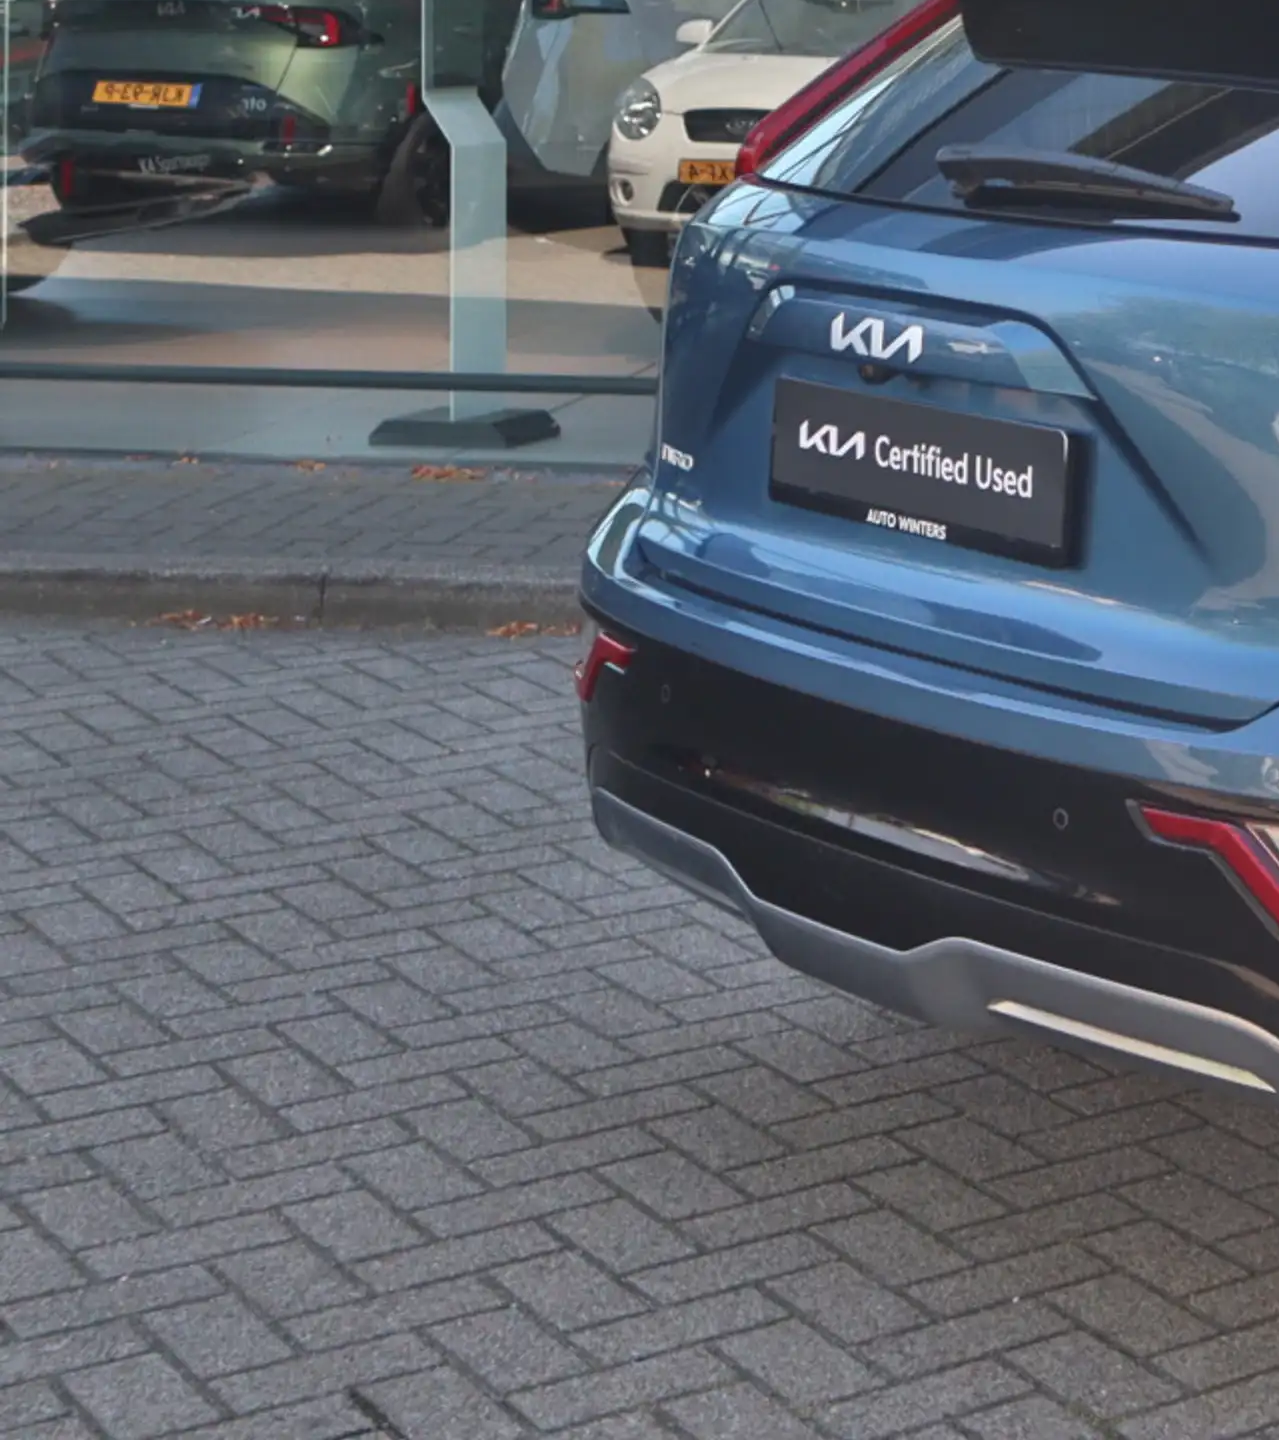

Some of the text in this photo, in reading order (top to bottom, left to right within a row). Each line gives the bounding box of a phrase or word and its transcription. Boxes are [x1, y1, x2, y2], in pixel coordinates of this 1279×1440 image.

[830, 311, 924, 364] KIA
[799, 419, 1034, 499] KIA Certified Used
[865, 508, 948, 541] AUTO WINTERS
